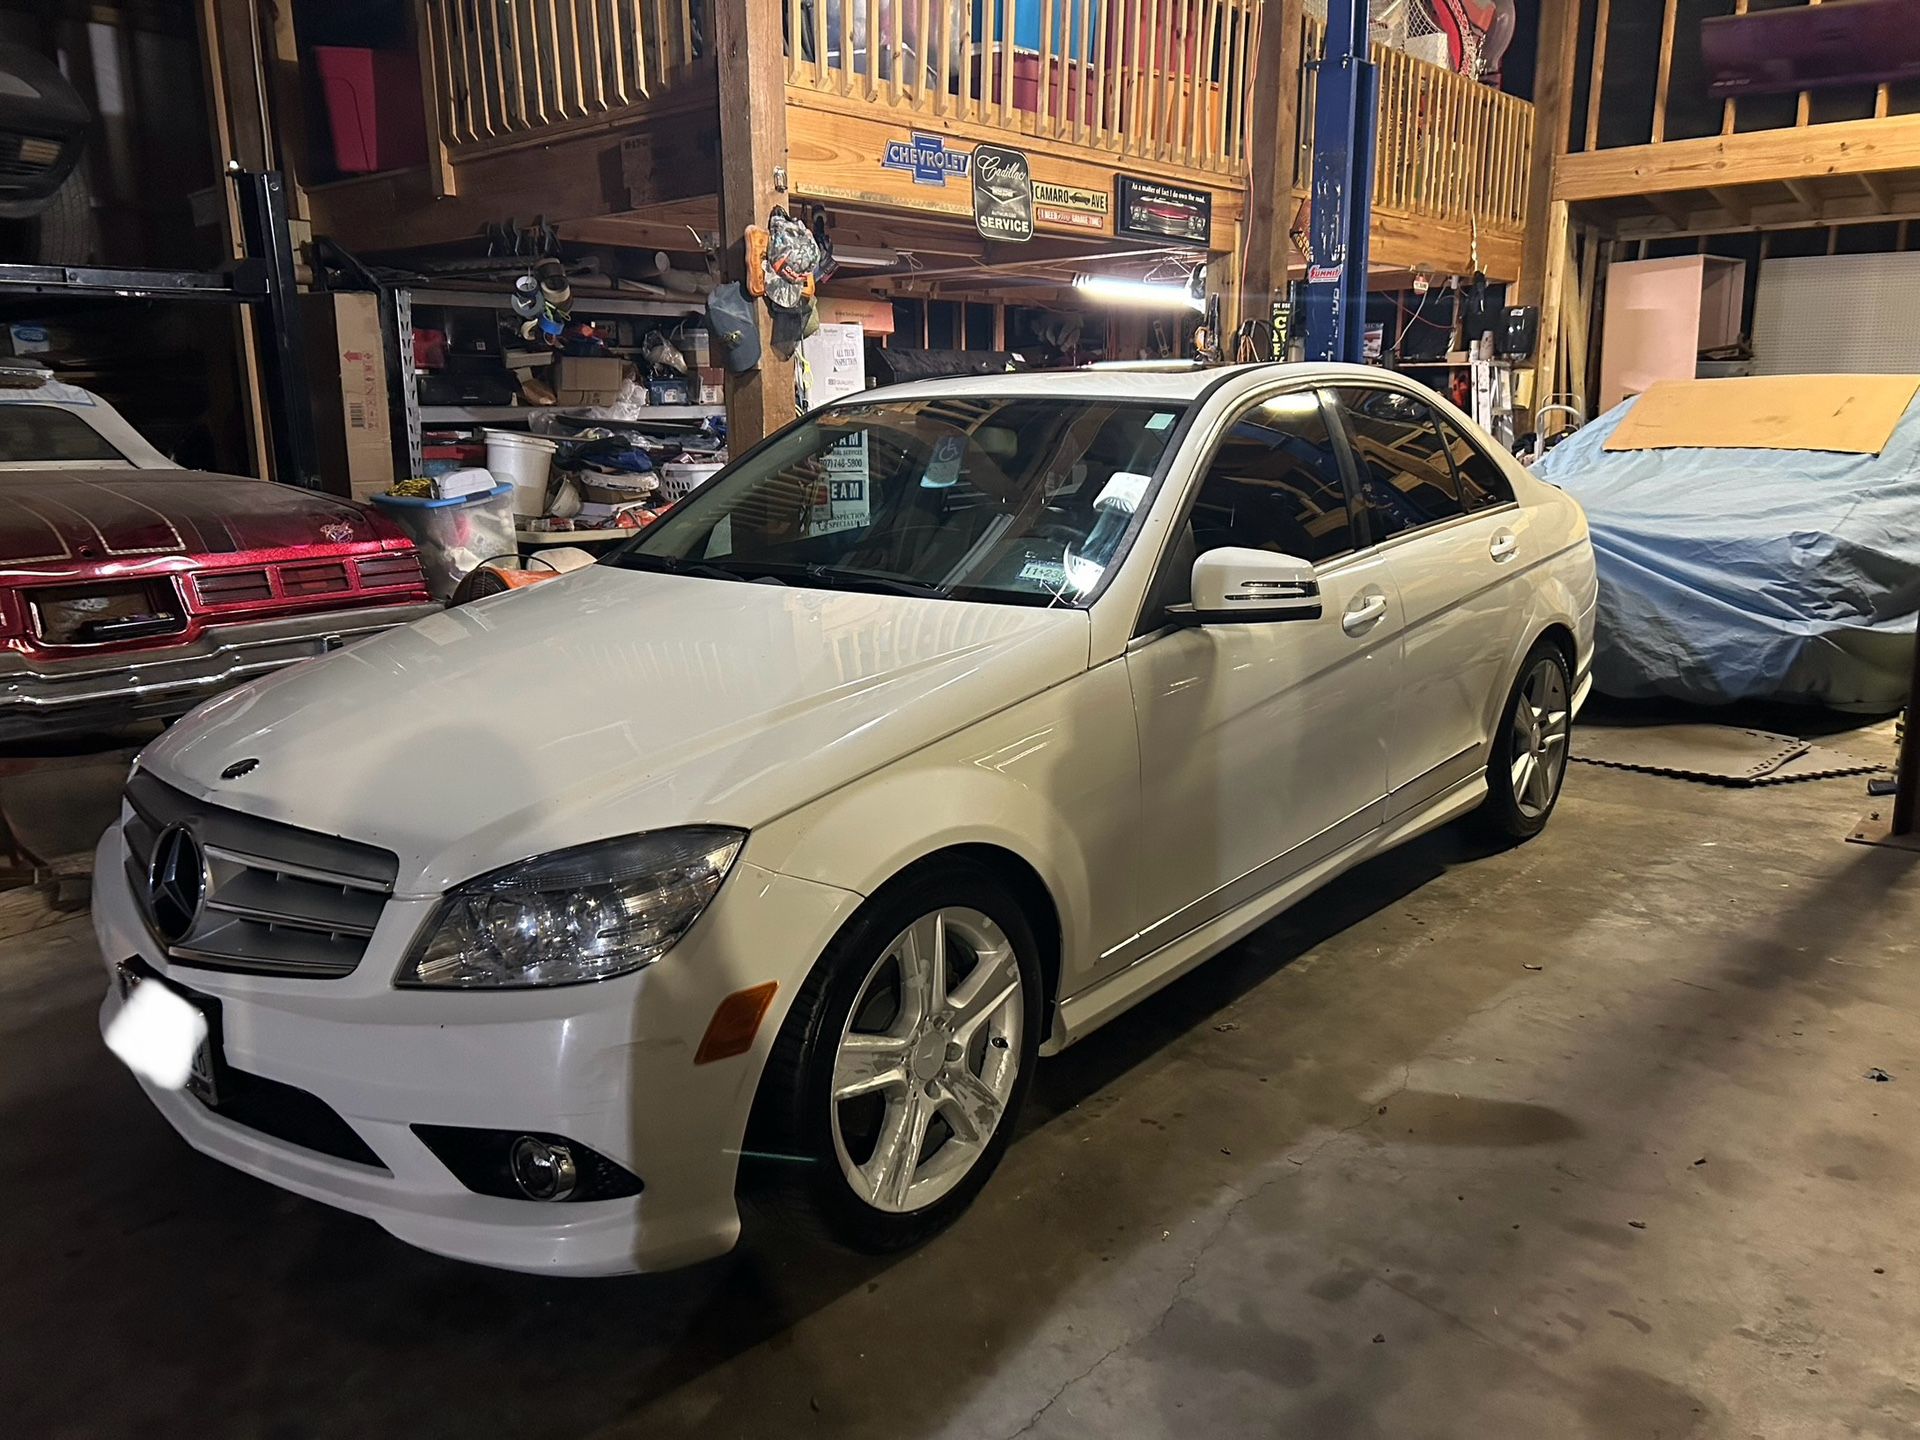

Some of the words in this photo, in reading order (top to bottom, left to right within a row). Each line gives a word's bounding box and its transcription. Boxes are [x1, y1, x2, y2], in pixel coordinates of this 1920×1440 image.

[889, 145, 965, 171] CHEVROLET
[977, 155, 1026, 182] Cadillac
[1034, 185, 1069, 204] CAMARO
[1091, 193, 1104, 209] AVE
[1131, 182, 1138, 190] As
[980, 215, 1029, 233] SERVICE
